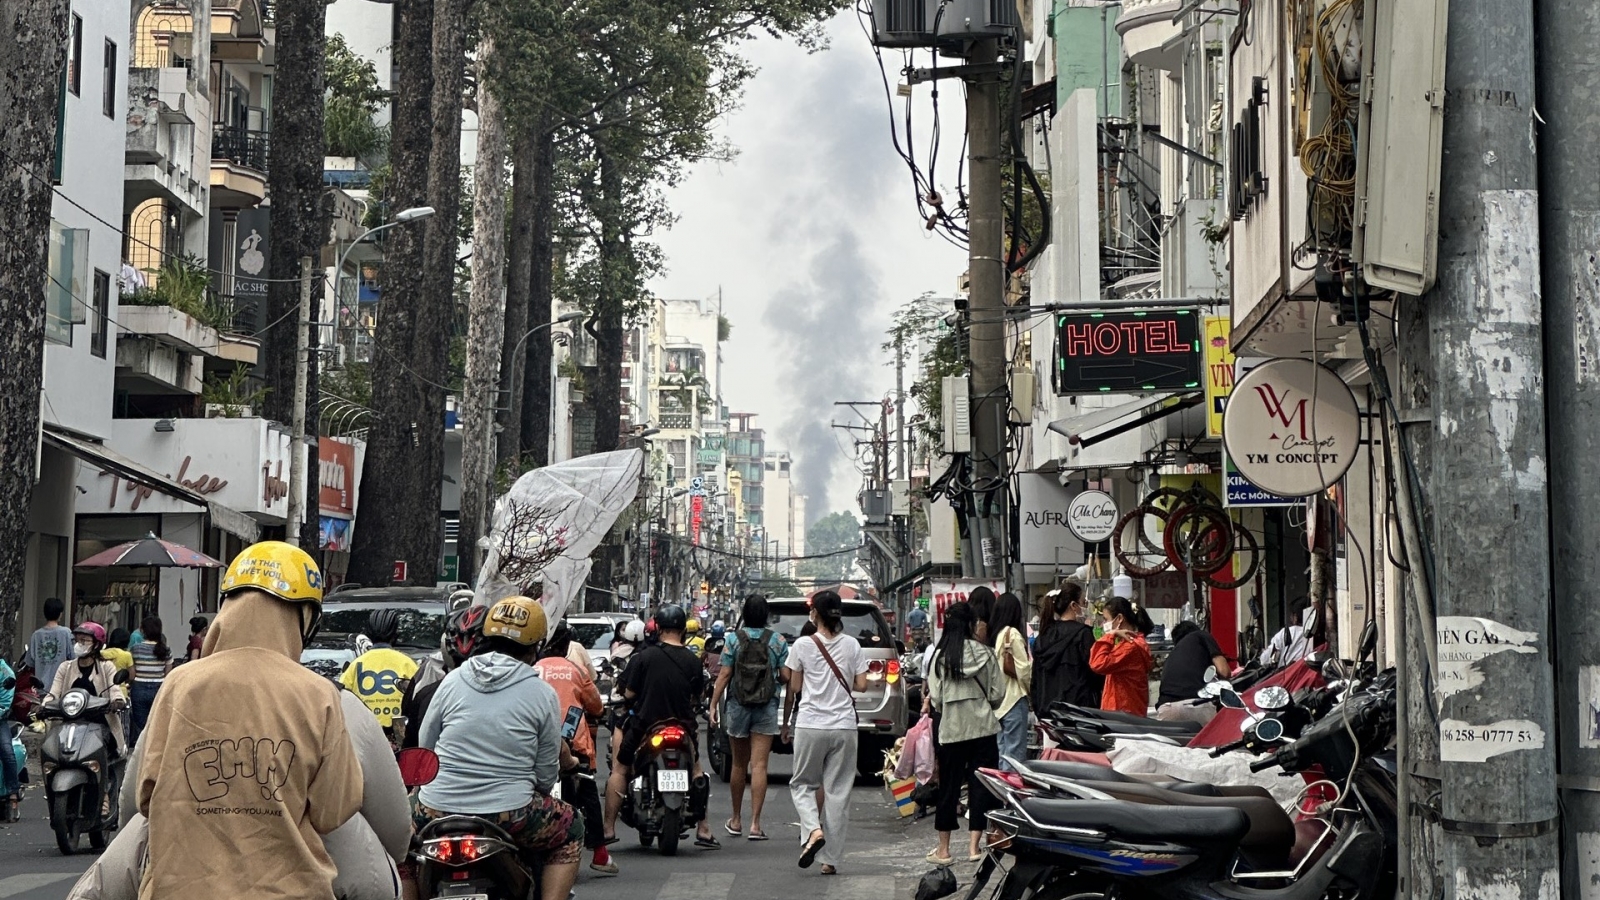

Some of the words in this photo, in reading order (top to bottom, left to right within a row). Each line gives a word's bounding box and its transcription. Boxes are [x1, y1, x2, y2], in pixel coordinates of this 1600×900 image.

[1067, 320, 1190, 356] HOTEL
[1246, 454, 1269, 464] YM
[1275, 453, 1338, 464] CONCEPT
[1228, 491, 1247, 500] CÁC
[1249, 491, 1270, 500] MÓN
[1024, 510, 1069, 528] AUFR
[357, 661, 399, 696] be
[545, 671, 573, 681] Food
